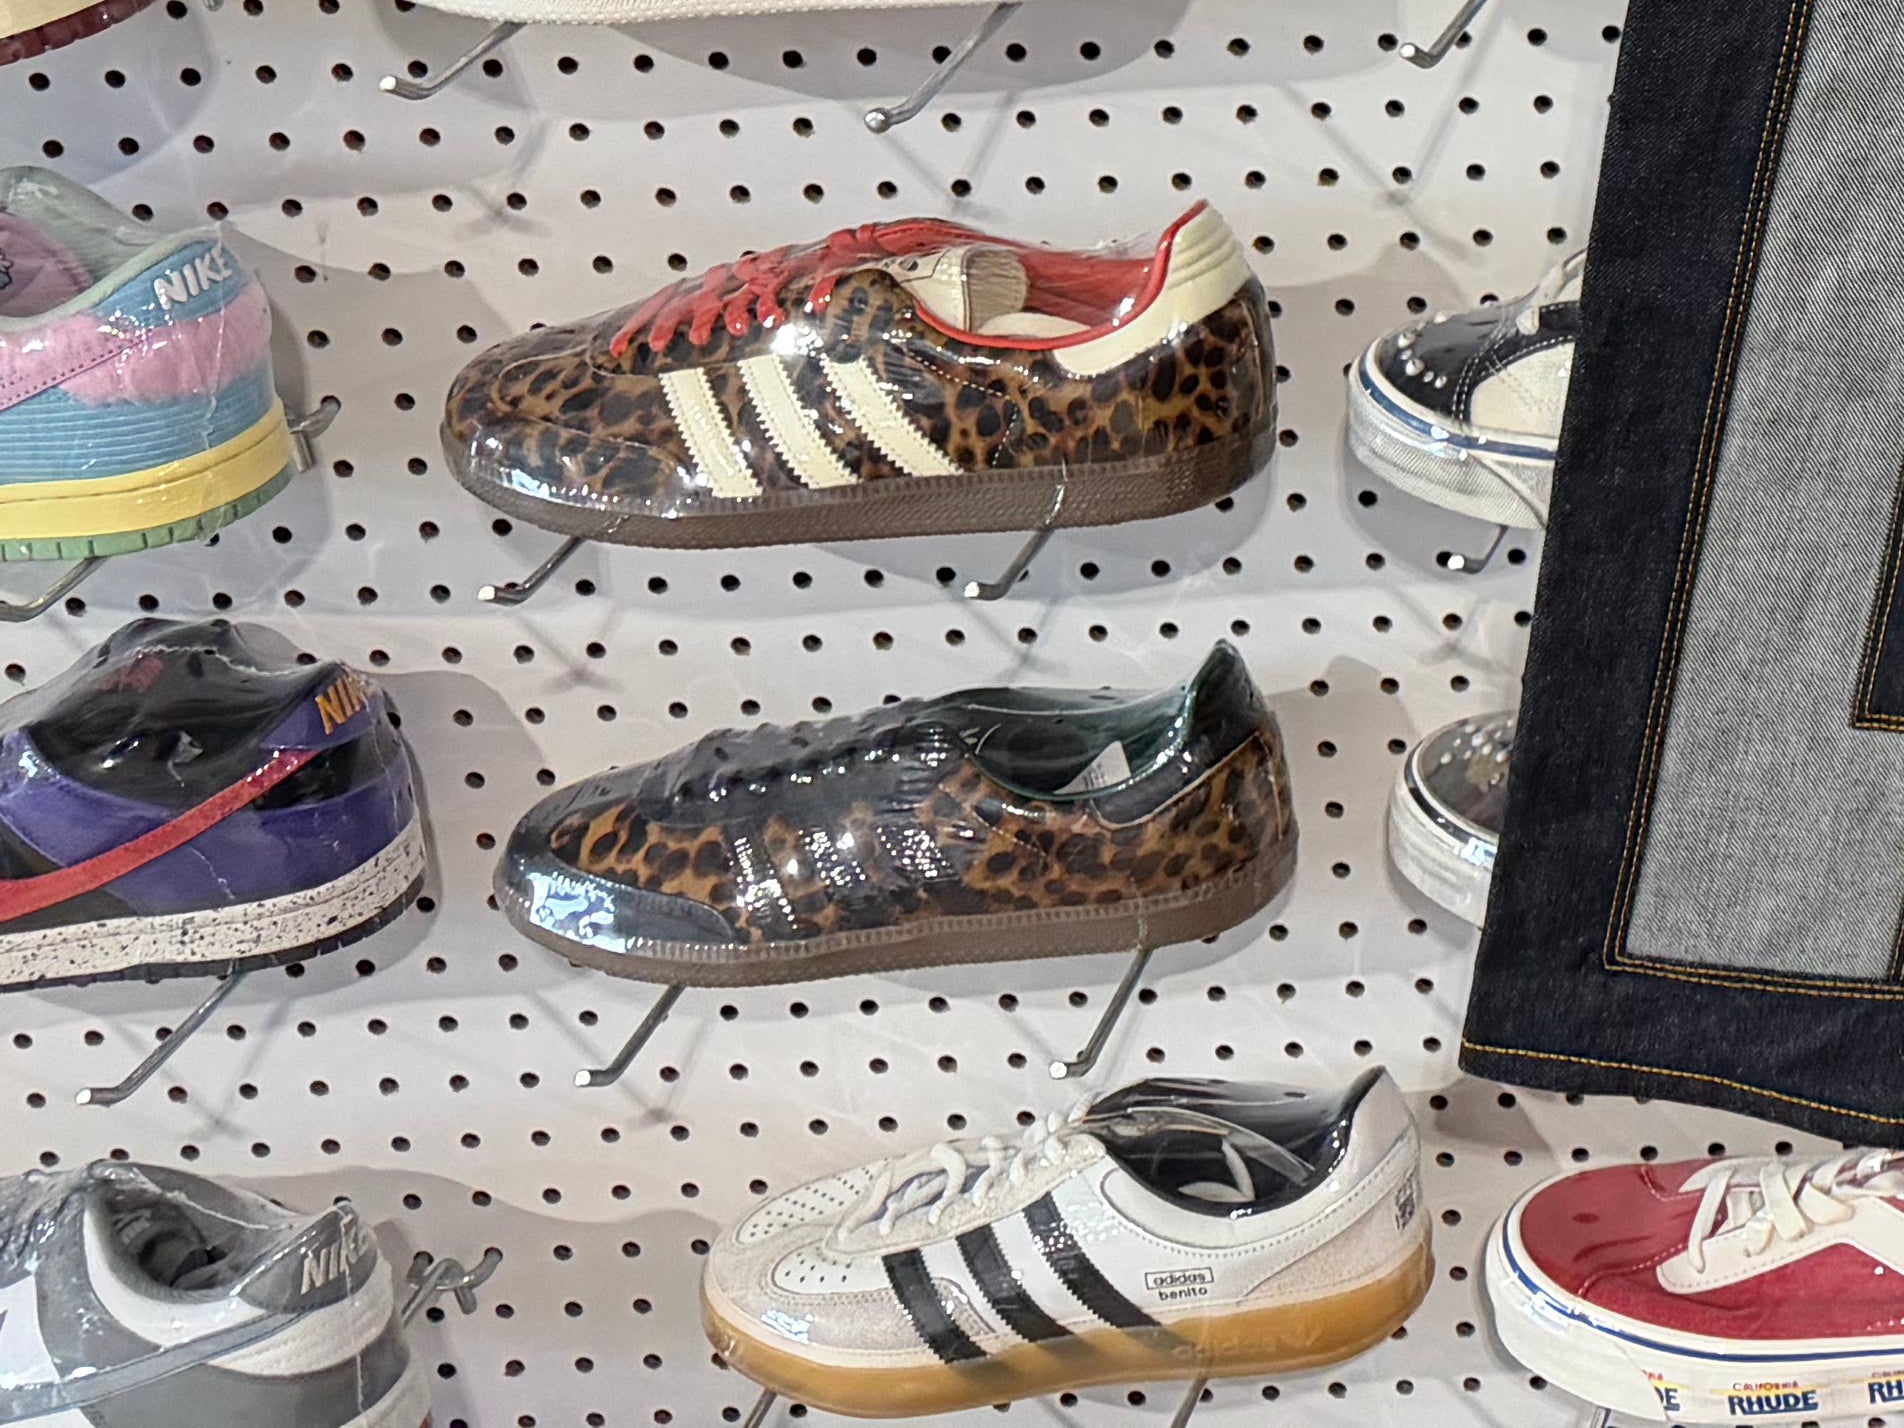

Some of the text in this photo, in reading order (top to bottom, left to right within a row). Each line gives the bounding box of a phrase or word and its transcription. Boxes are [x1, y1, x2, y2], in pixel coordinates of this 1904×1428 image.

[153, 247, 233, 311] NIKE
[1153, 1271, 1207, 1287] adidas
[1158, 1287, 1208, 1301] benito
[1727, 1389, 1819, 1416] RHUDE
